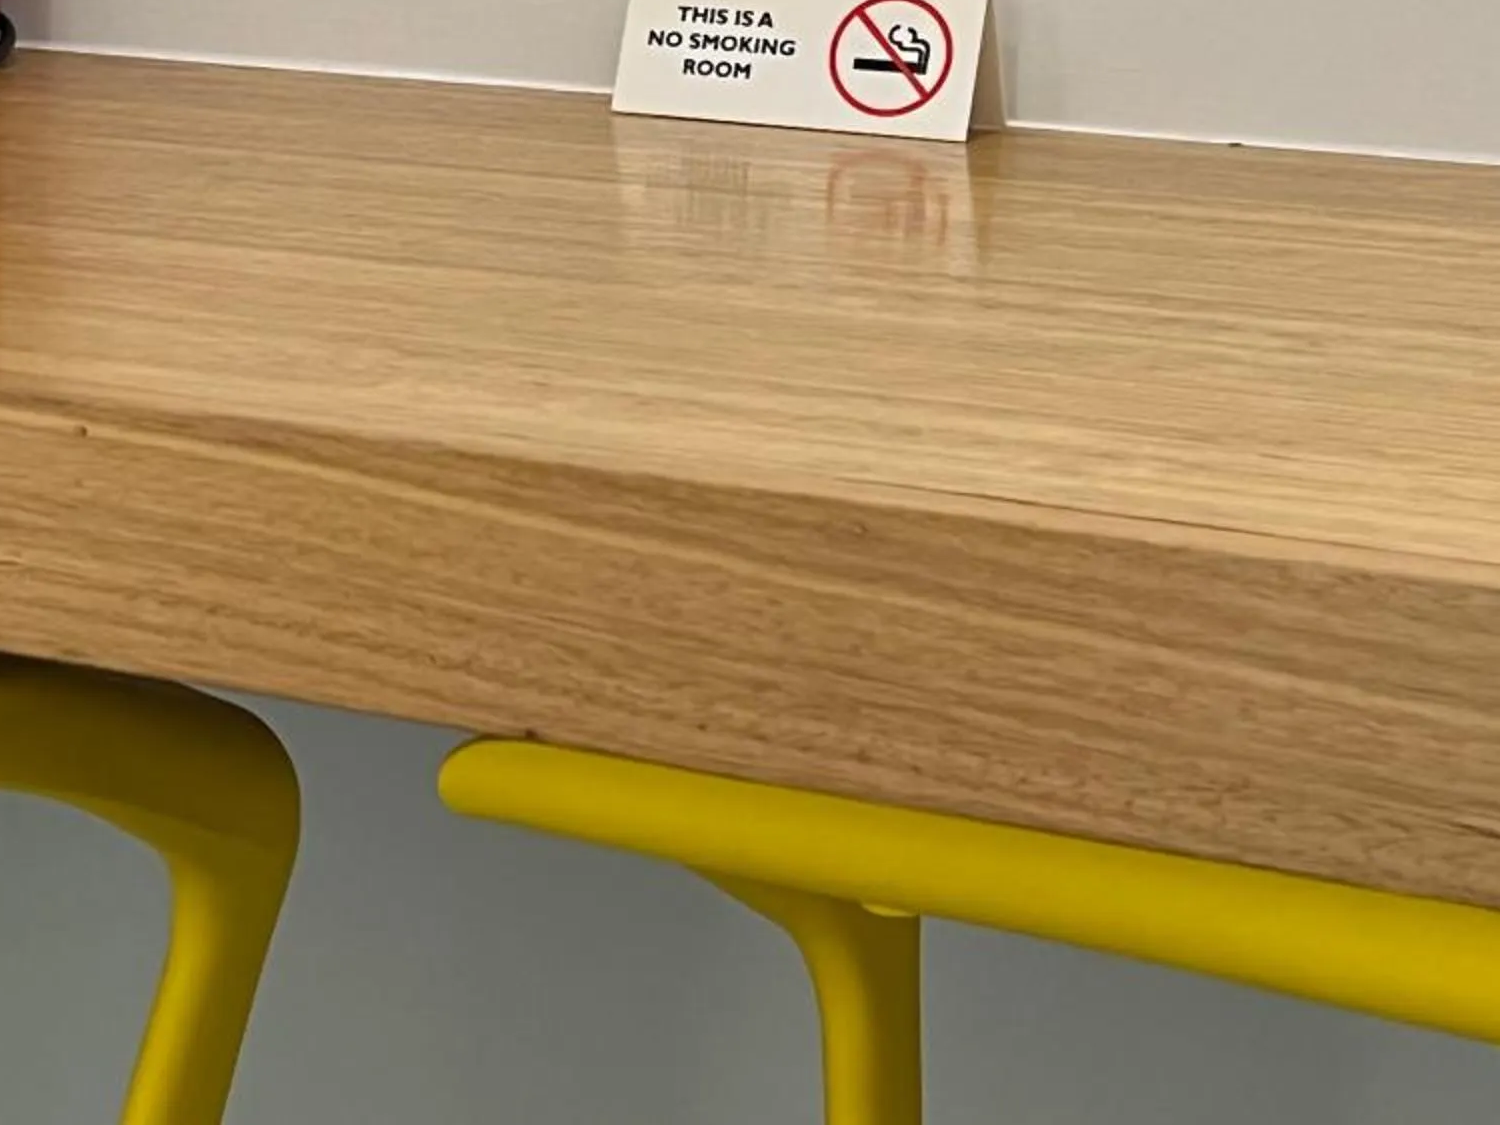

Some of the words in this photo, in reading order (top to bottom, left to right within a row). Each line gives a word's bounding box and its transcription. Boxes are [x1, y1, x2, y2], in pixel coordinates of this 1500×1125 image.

[677, 5, 729, 27] THIS
[734, 7, 753, 28] IS
[757, 10, 774, 29] A
[647, 29, 684, 49] NO
[689, 32, 797, 57] SMOKING
[682, 58, 753, 80] ROOM
